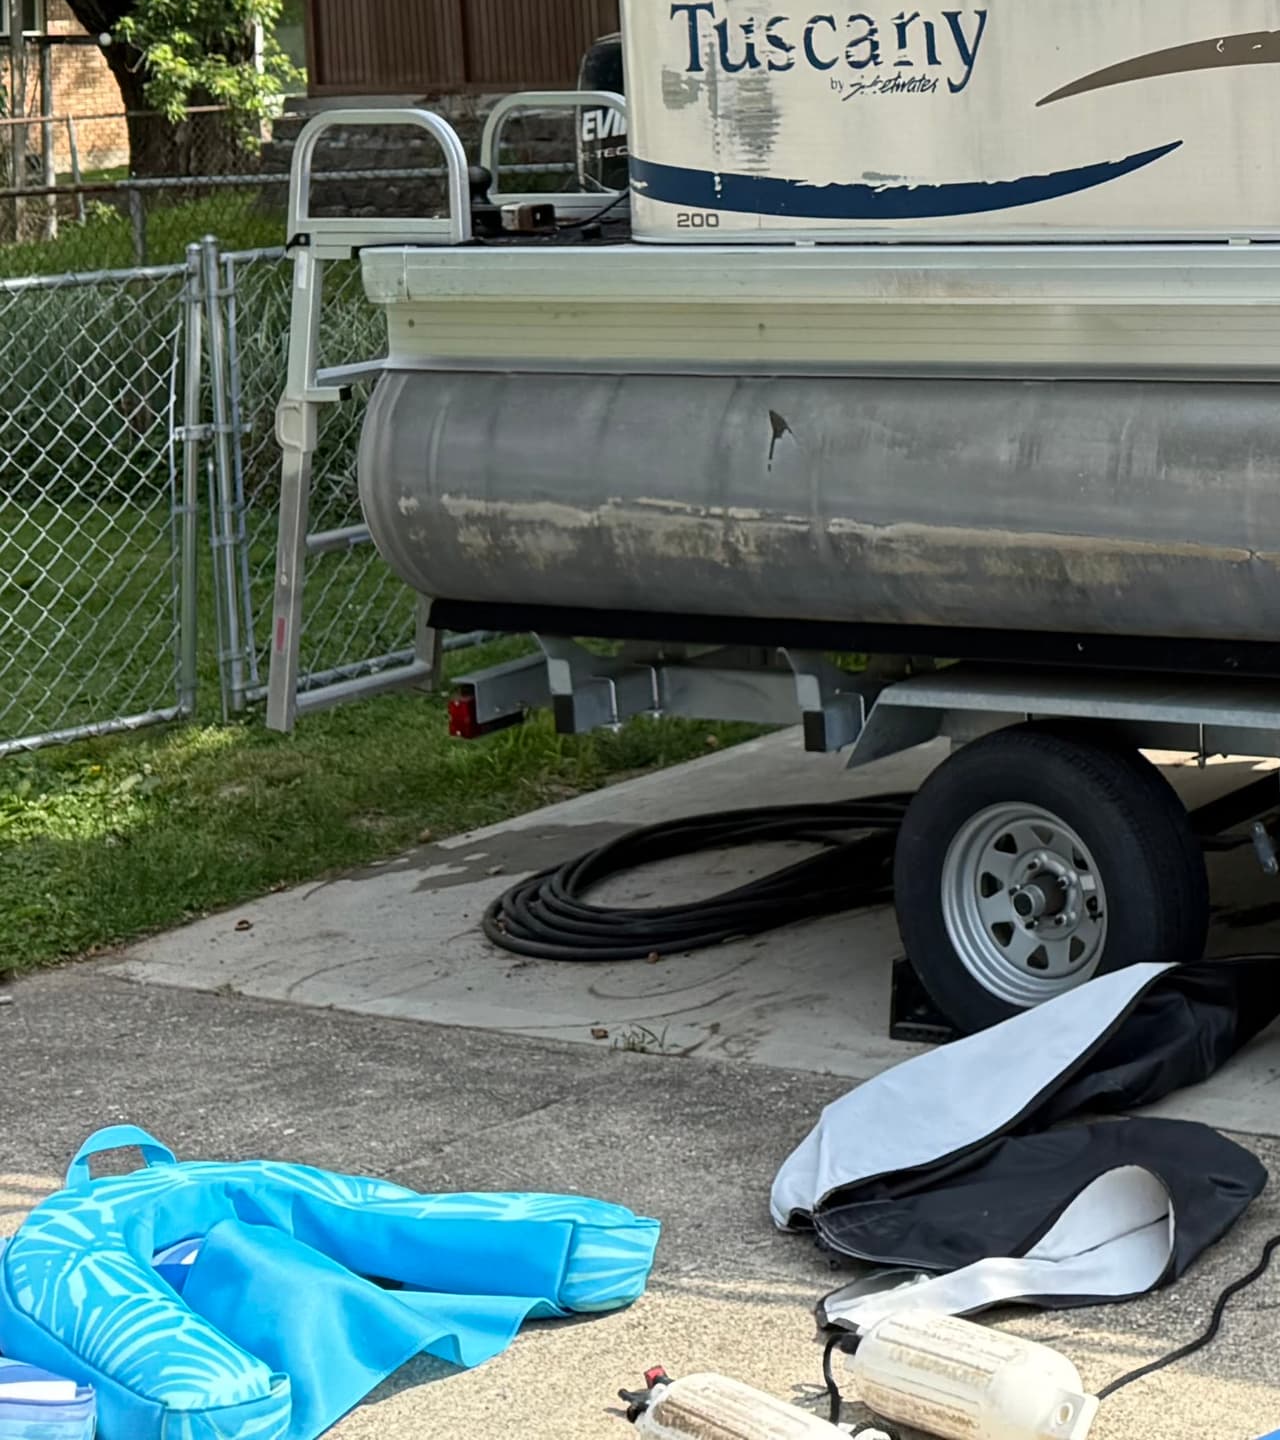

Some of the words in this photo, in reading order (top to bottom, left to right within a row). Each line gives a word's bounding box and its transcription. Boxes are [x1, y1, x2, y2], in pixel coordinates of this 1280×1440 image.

[669, 1, 988, 94] Tuscany
[830, 76, 844, 93] by
[676, 212, 720, 229] 200
